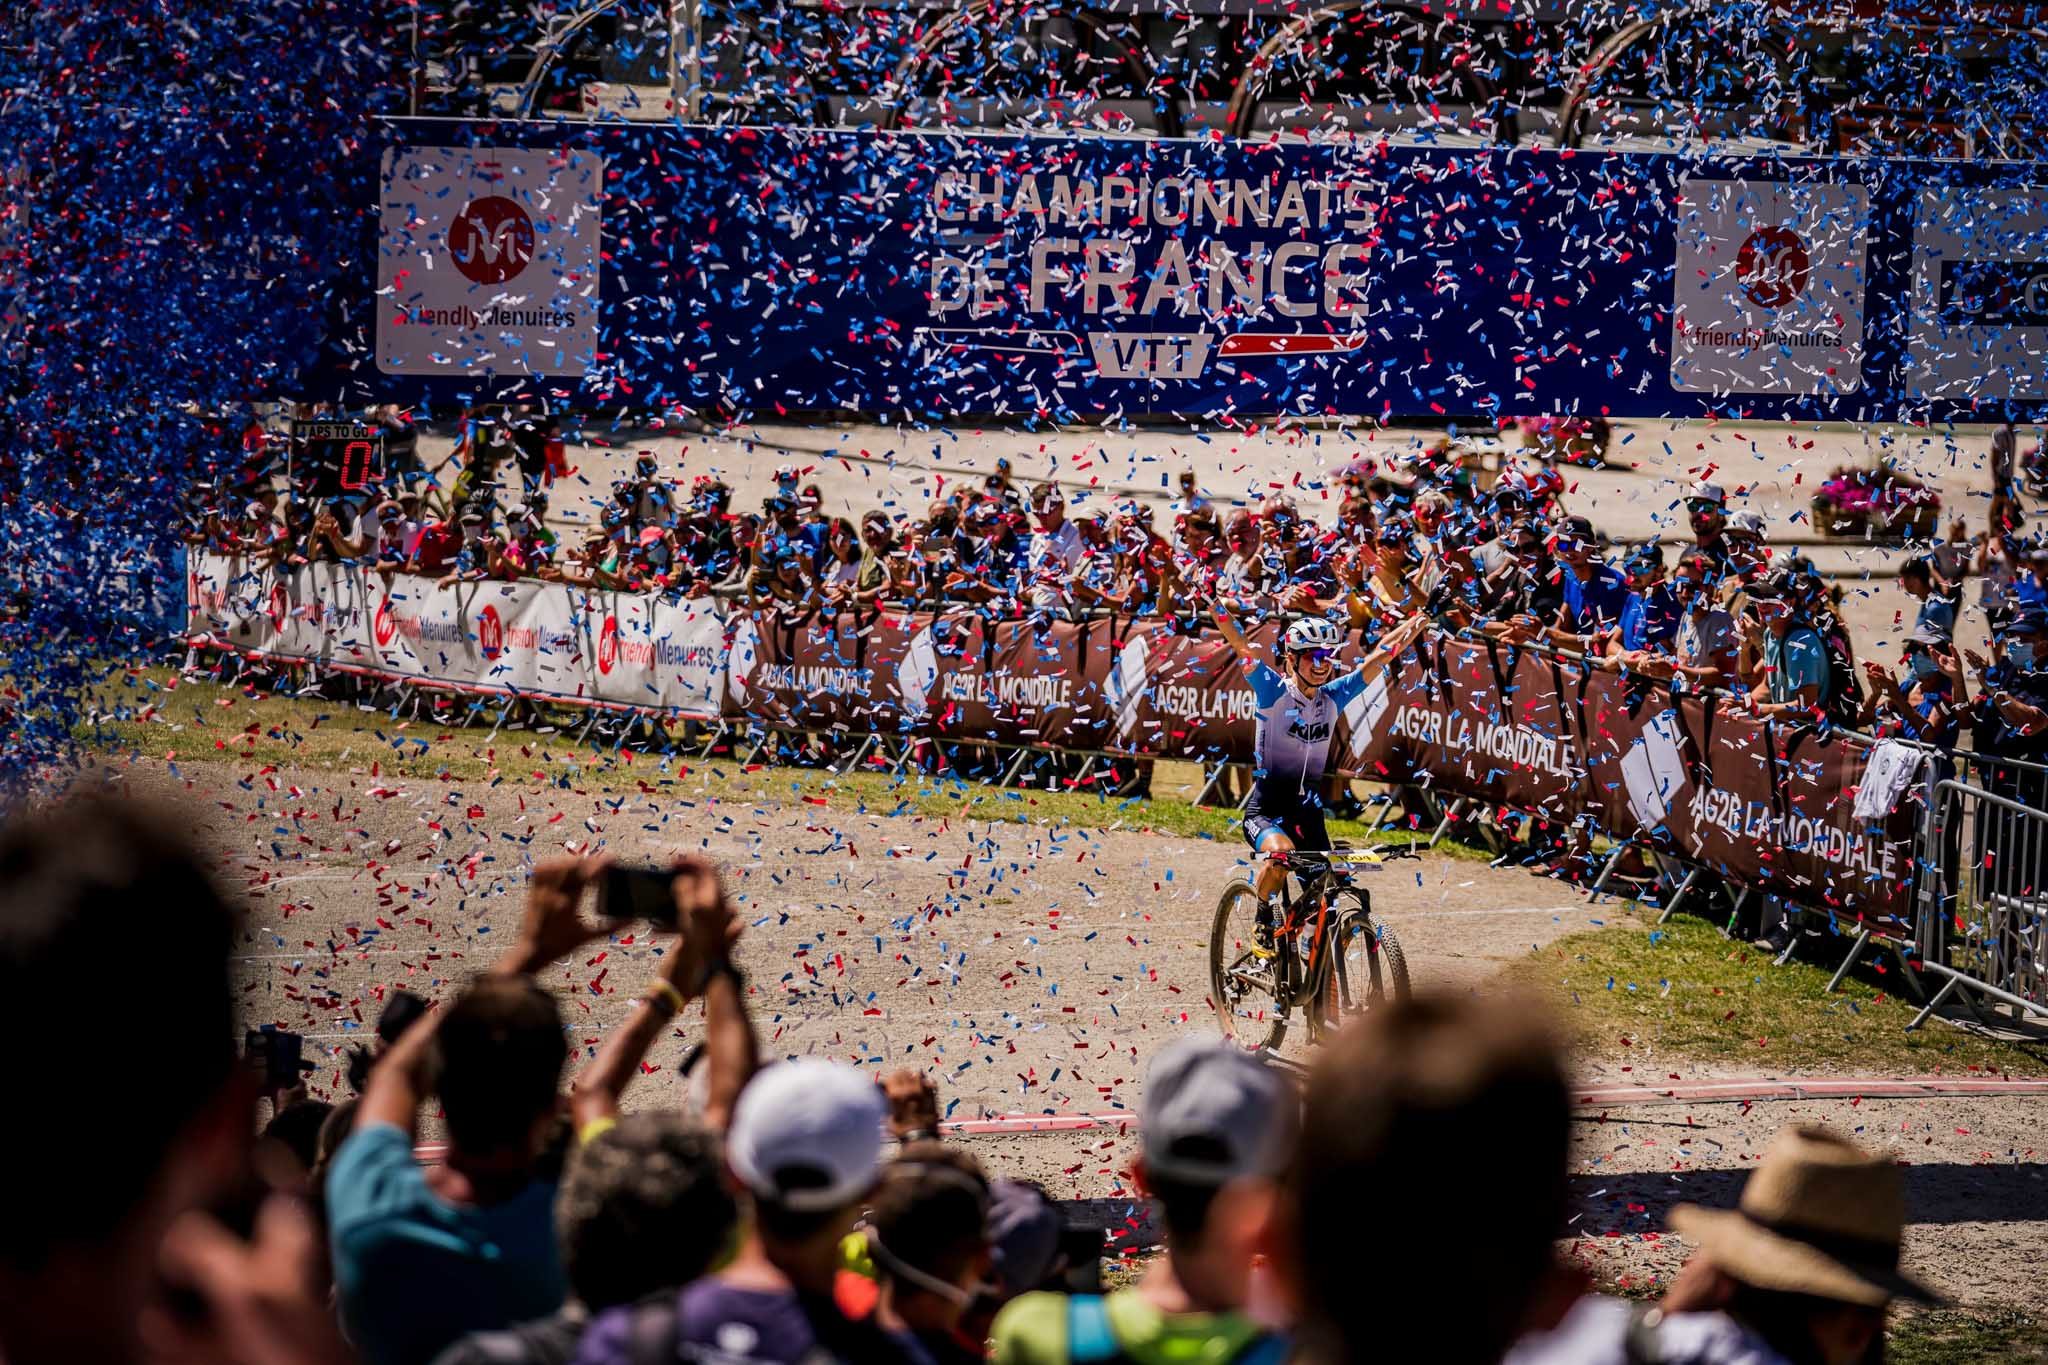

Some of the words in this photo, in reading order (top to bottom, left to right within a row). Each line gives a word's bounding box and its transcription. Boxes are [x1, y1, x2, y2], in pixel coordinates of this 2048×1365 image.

[934, 171, 1374, 230] CHAMPIONNATS
[930, 256, 1009, 312] DE
[1030, 238, 1371, 318] FRANCE
[399, 303, 576, 330] endlyMenuires
[1108, 337, 1193, 374] VTT
[334, 426, 350, 438] TO
[352, 426, 369, 438] GO
[341, 441, 372, 490] 0
[942, 671, 975, 701] AG2R
[999, 677, 1072, 708] MONDIALE
[1155, 684, 1198, 716] AG2R
[1202, 688, 1223, 718] LA
[1391, 704, 1442, 745] AG2R
[1445, 714, 1472, 750] LA
[1475, 720, 1576, 778] MONDIALE
[1690, 784, 1742, 832] AG2R
[1744, 801, 1772, 843] LA
[1776, 812, 1899, 880] MONDIALE
